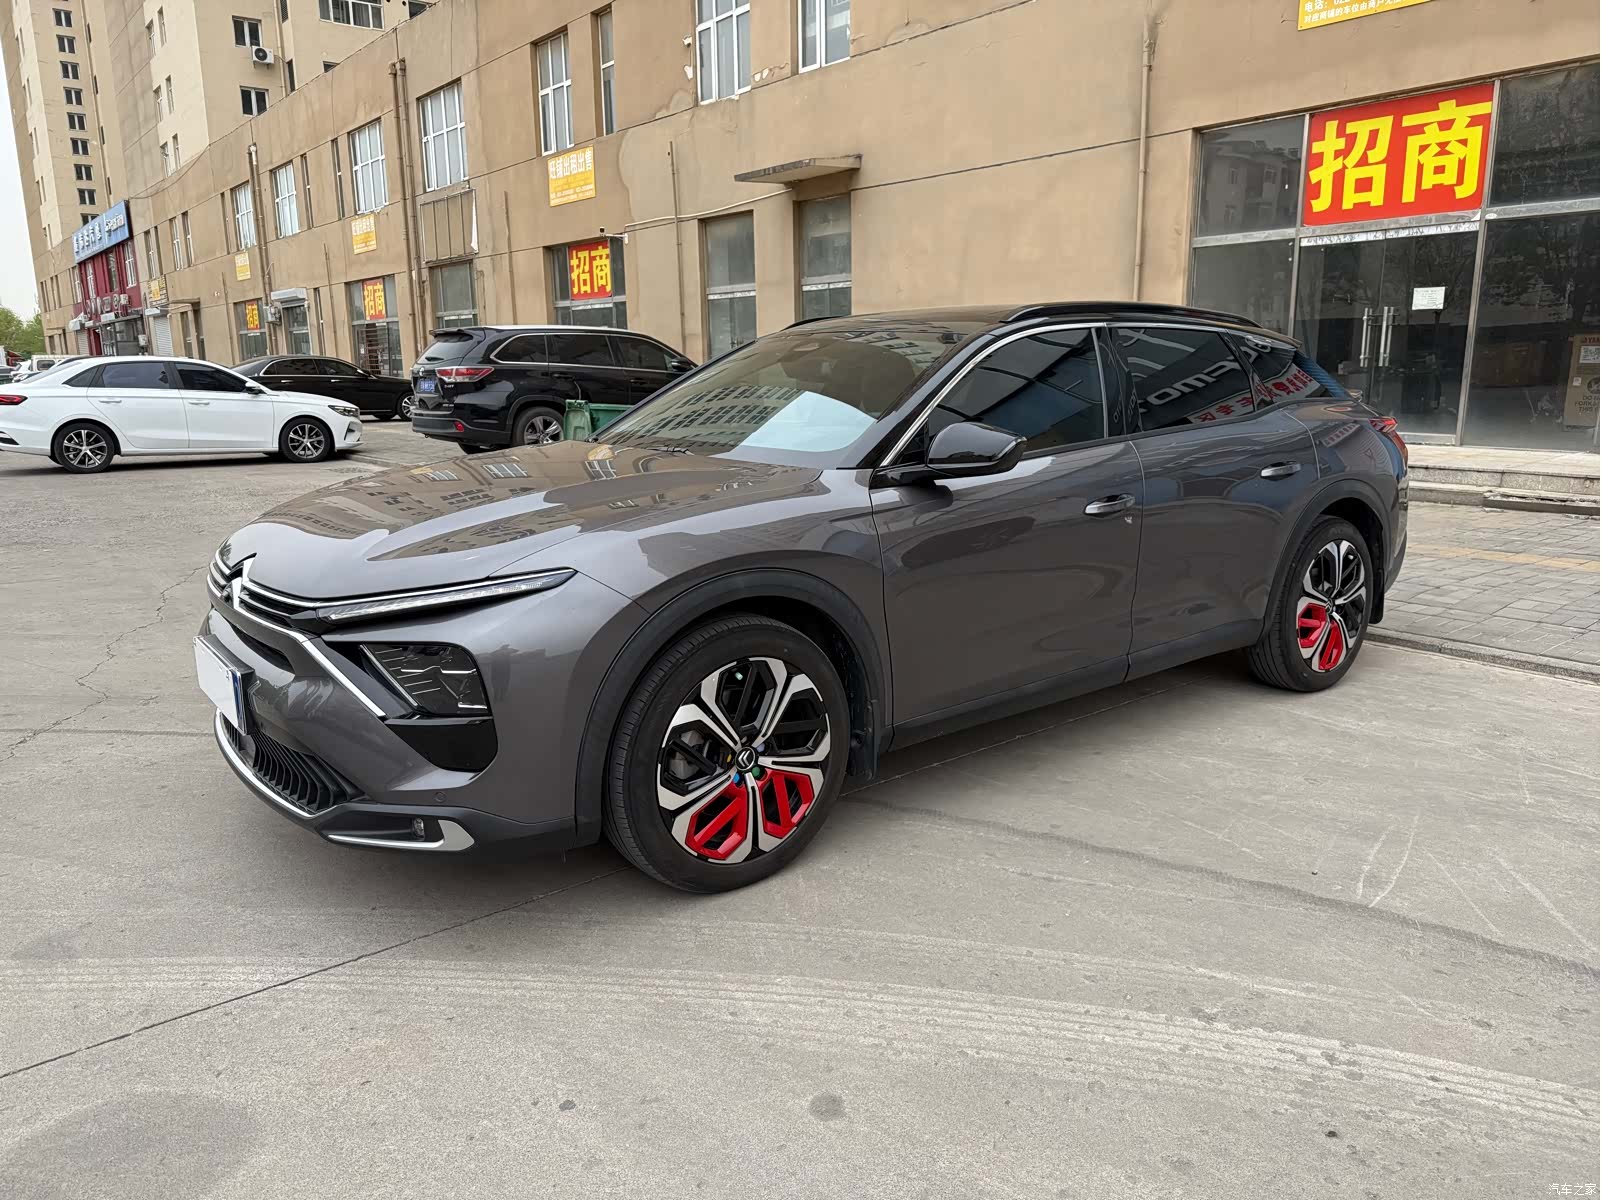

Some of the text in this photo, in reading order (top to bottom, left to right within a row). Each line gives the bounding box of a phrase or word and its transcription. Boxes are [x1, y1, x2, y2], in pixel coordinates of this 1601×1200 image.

[1308, 99, 1492, 213] 招商
[570, 245, 611, 295] 招商
[246, 303, 259, 329] 招商
[364, 282, 385, 319] 招商
